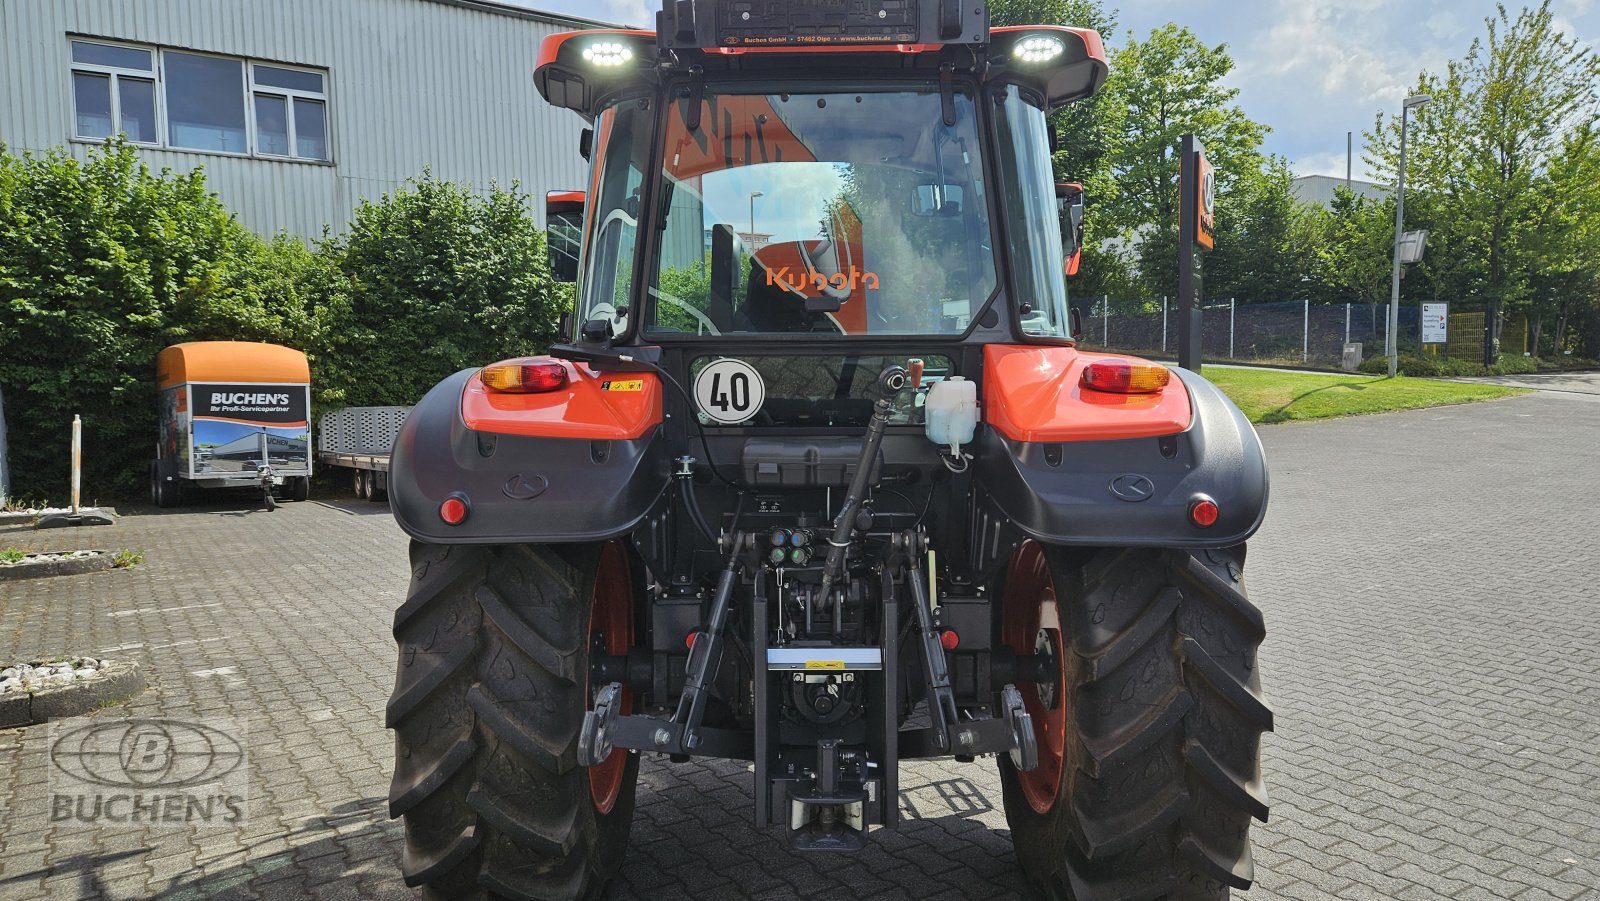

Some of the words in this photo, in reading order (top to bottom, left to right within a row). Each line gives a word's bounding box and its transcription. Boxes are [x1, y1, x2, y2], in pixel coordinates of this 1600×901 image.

[766, 265, 880, 291] Kubota
[211, 392, 289, 404] BUCHEN'S
[710, 372, 750, 412] 40
